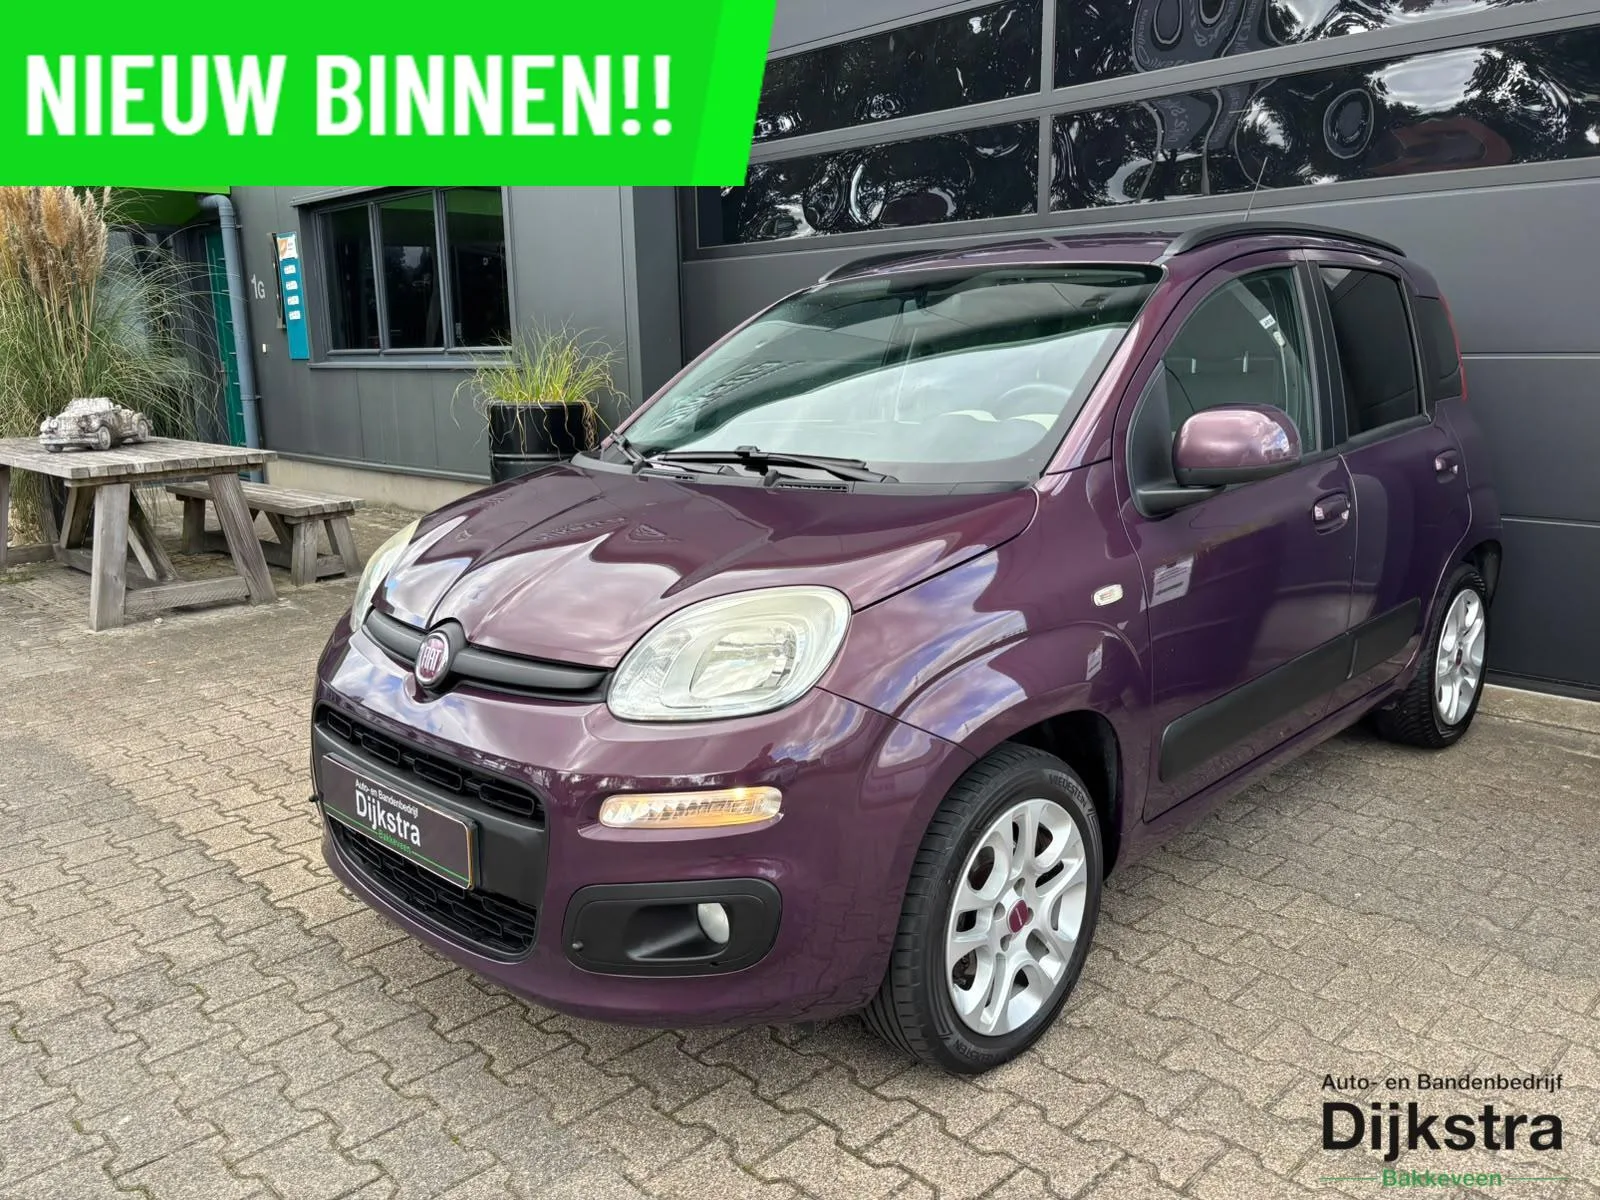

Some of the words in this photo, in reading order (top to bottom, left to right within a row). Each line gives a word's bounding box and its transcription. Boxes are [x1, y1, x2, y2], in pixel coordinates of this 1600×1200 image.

[250, 274, 266, 299] 1G
[421, 646, 443, 671] FIAT
[355, 778, 370, 793] Auto-
[355, 789, 421, 847] Dijkstra
